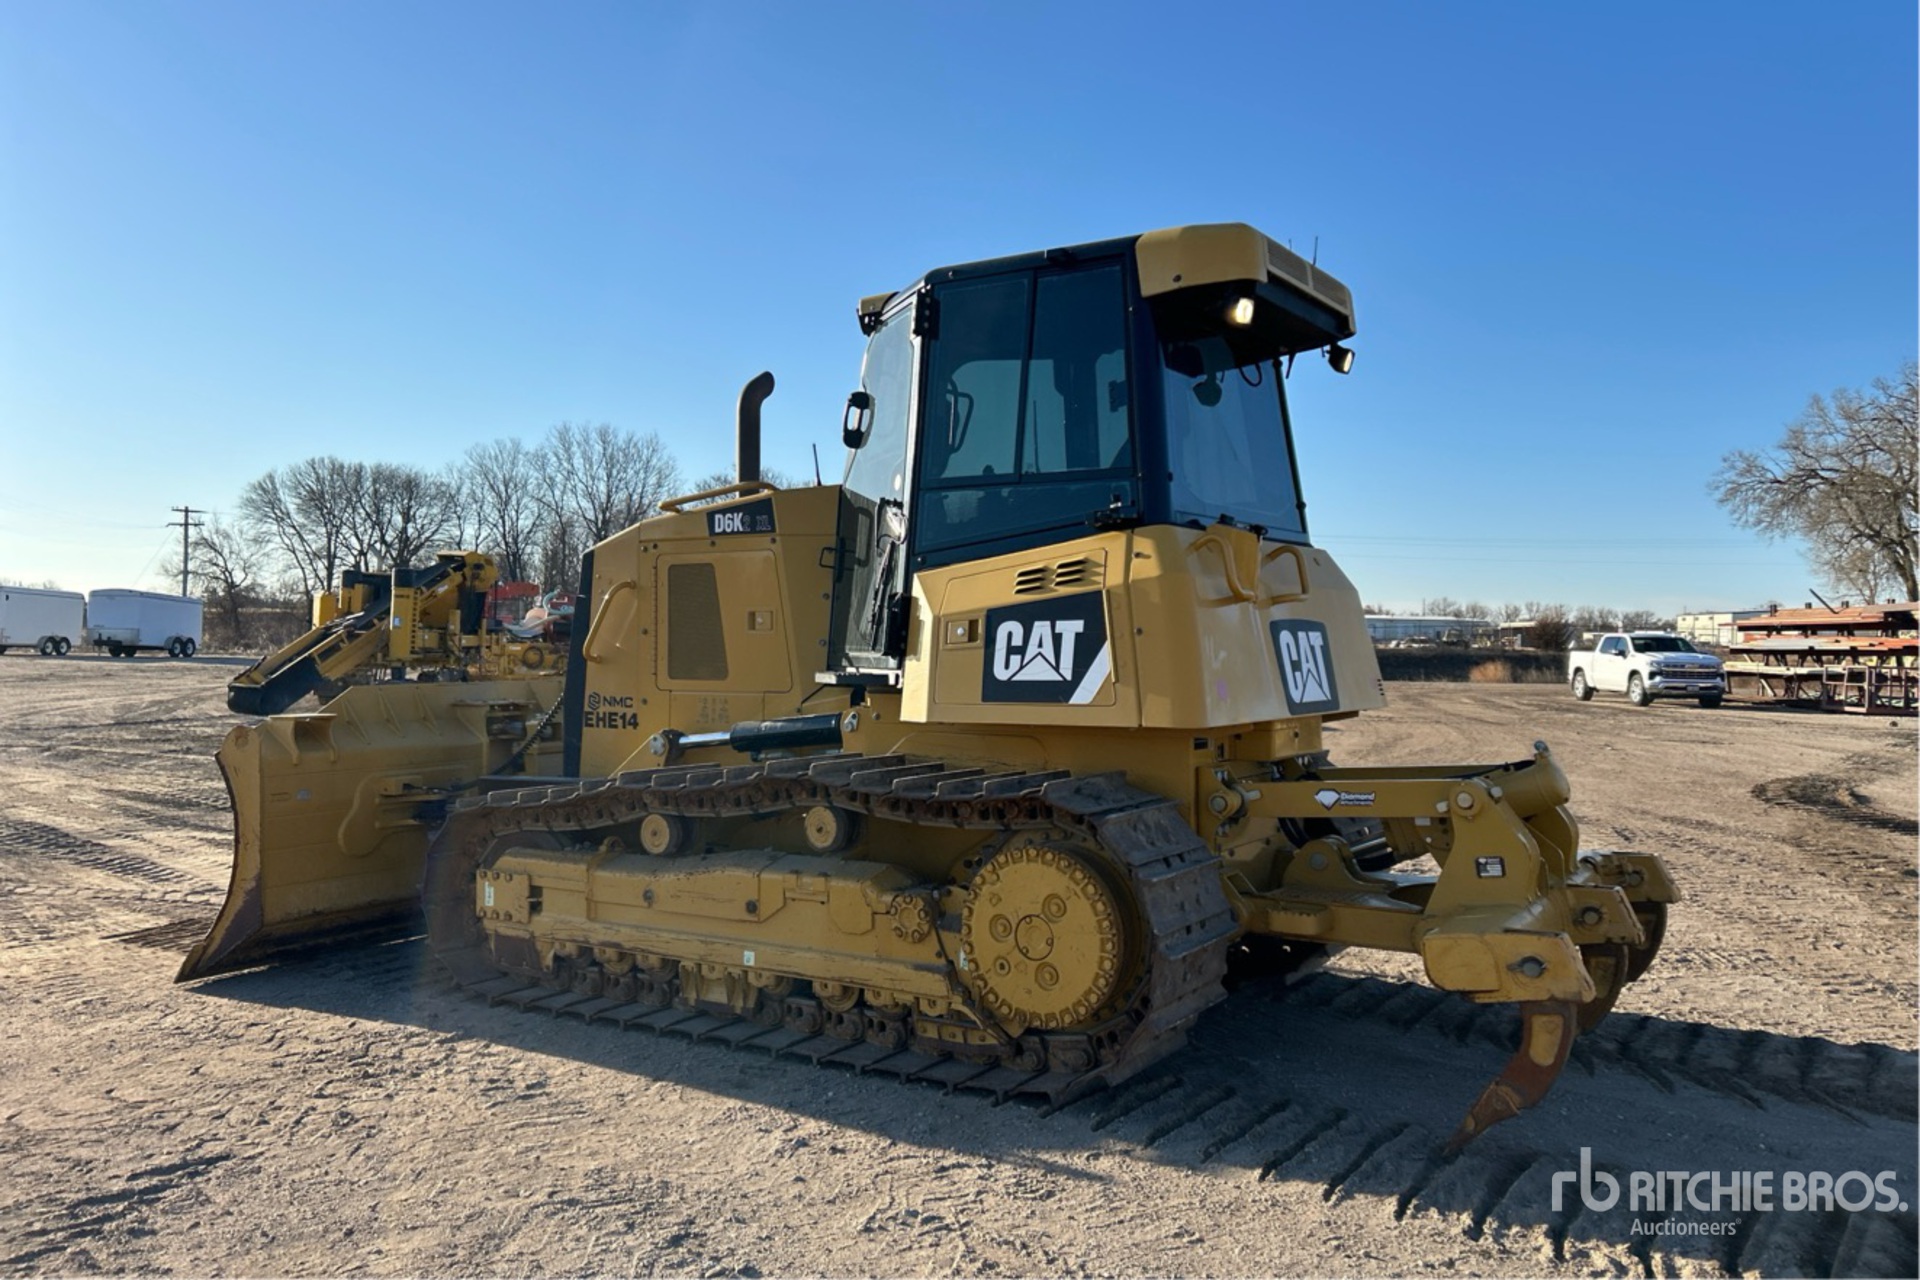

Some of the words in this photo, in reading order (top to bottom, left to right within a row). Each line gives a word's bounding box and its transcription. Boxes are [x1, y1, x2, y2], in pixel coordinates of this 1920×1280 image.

[993, 619, 1085, 681] CAT
[1279, 629, 1332, 704] CAT
[584, 711, 639, 729] EHE14
[603, 696, 634, 708] NMC
